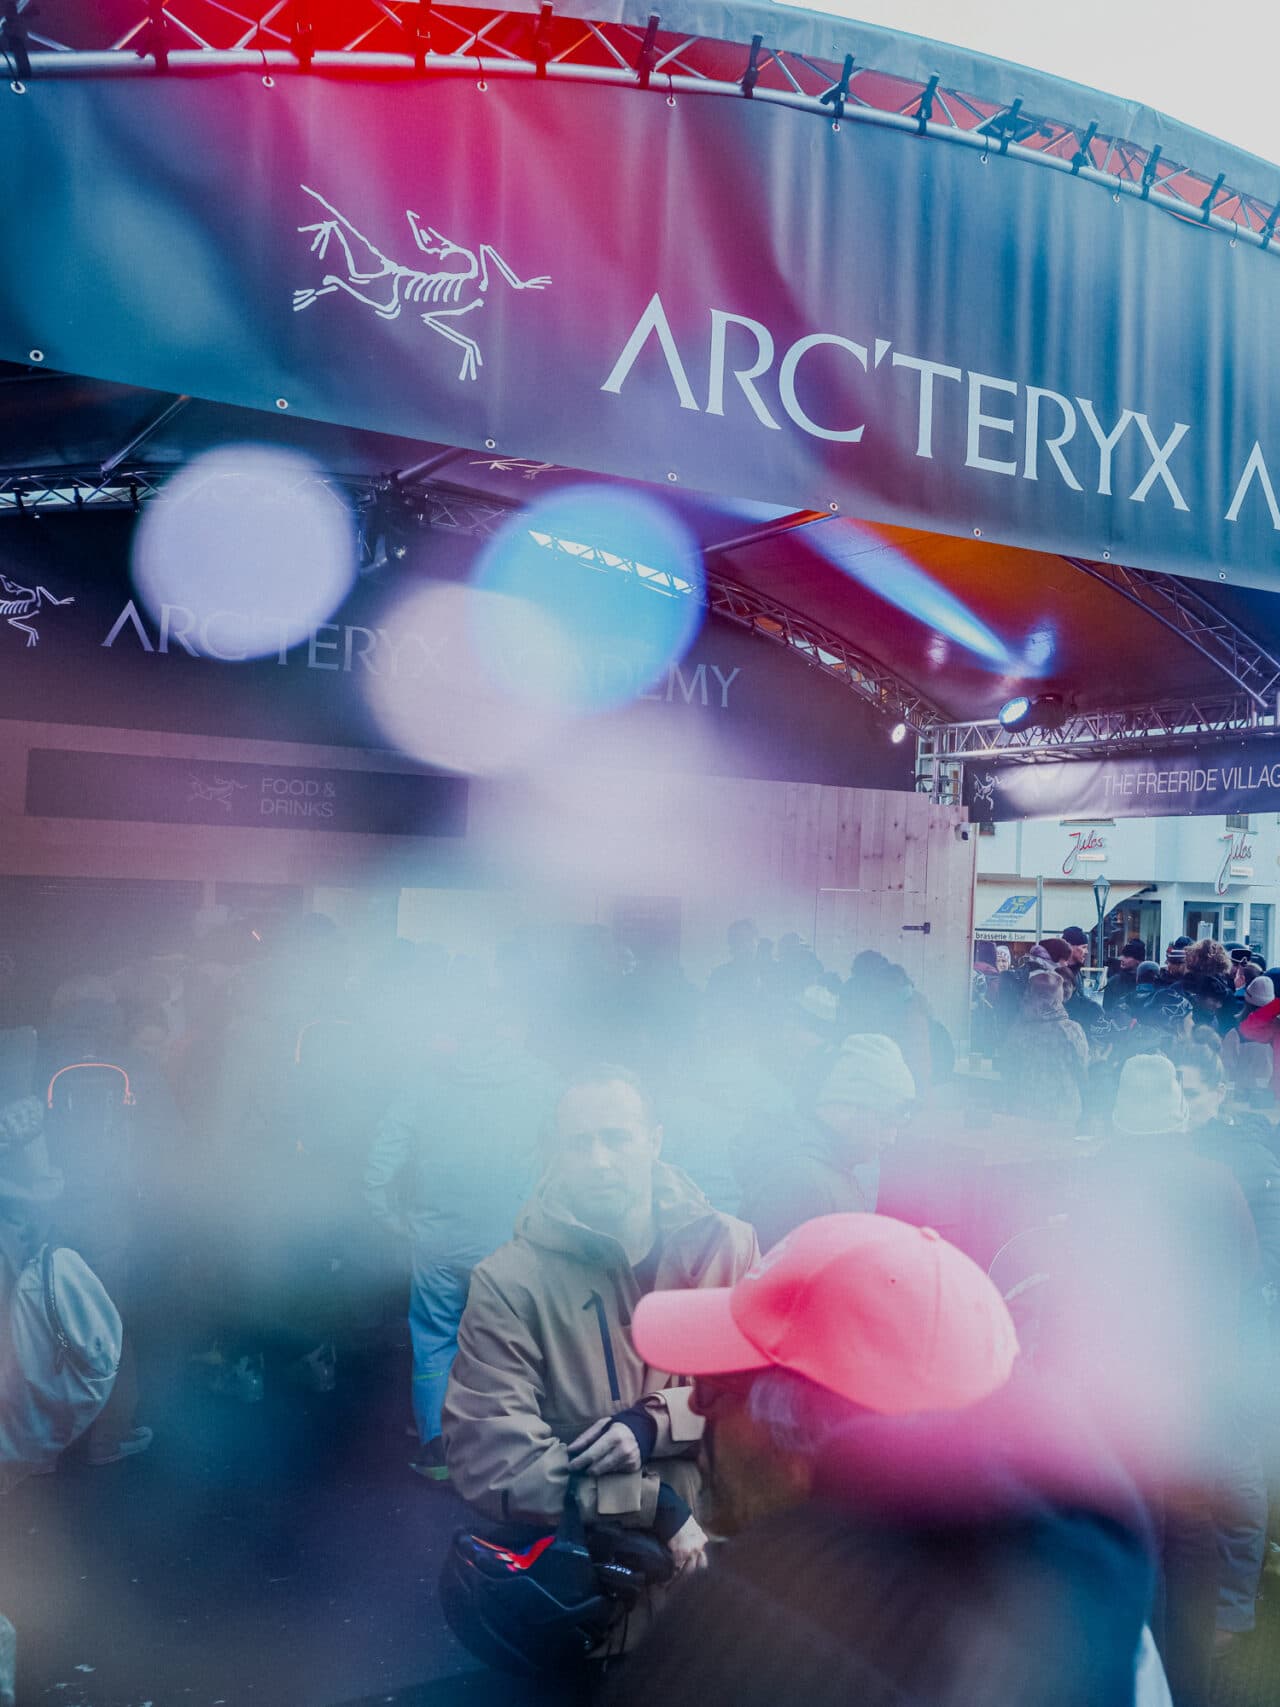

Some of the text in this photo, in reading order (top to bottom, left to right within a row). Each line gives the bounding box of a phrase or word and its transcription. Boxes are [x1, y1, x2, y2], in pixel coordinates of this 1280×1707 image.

[600, 292, 1191, 513] ARC'TERYX
[262, 776, 336, 798] FOOD &
[1103, 775, 1133, 796] THE
[1136, 768, 1218, 795] FREERIDE
[260, 798, 334, 818] DRINKS
